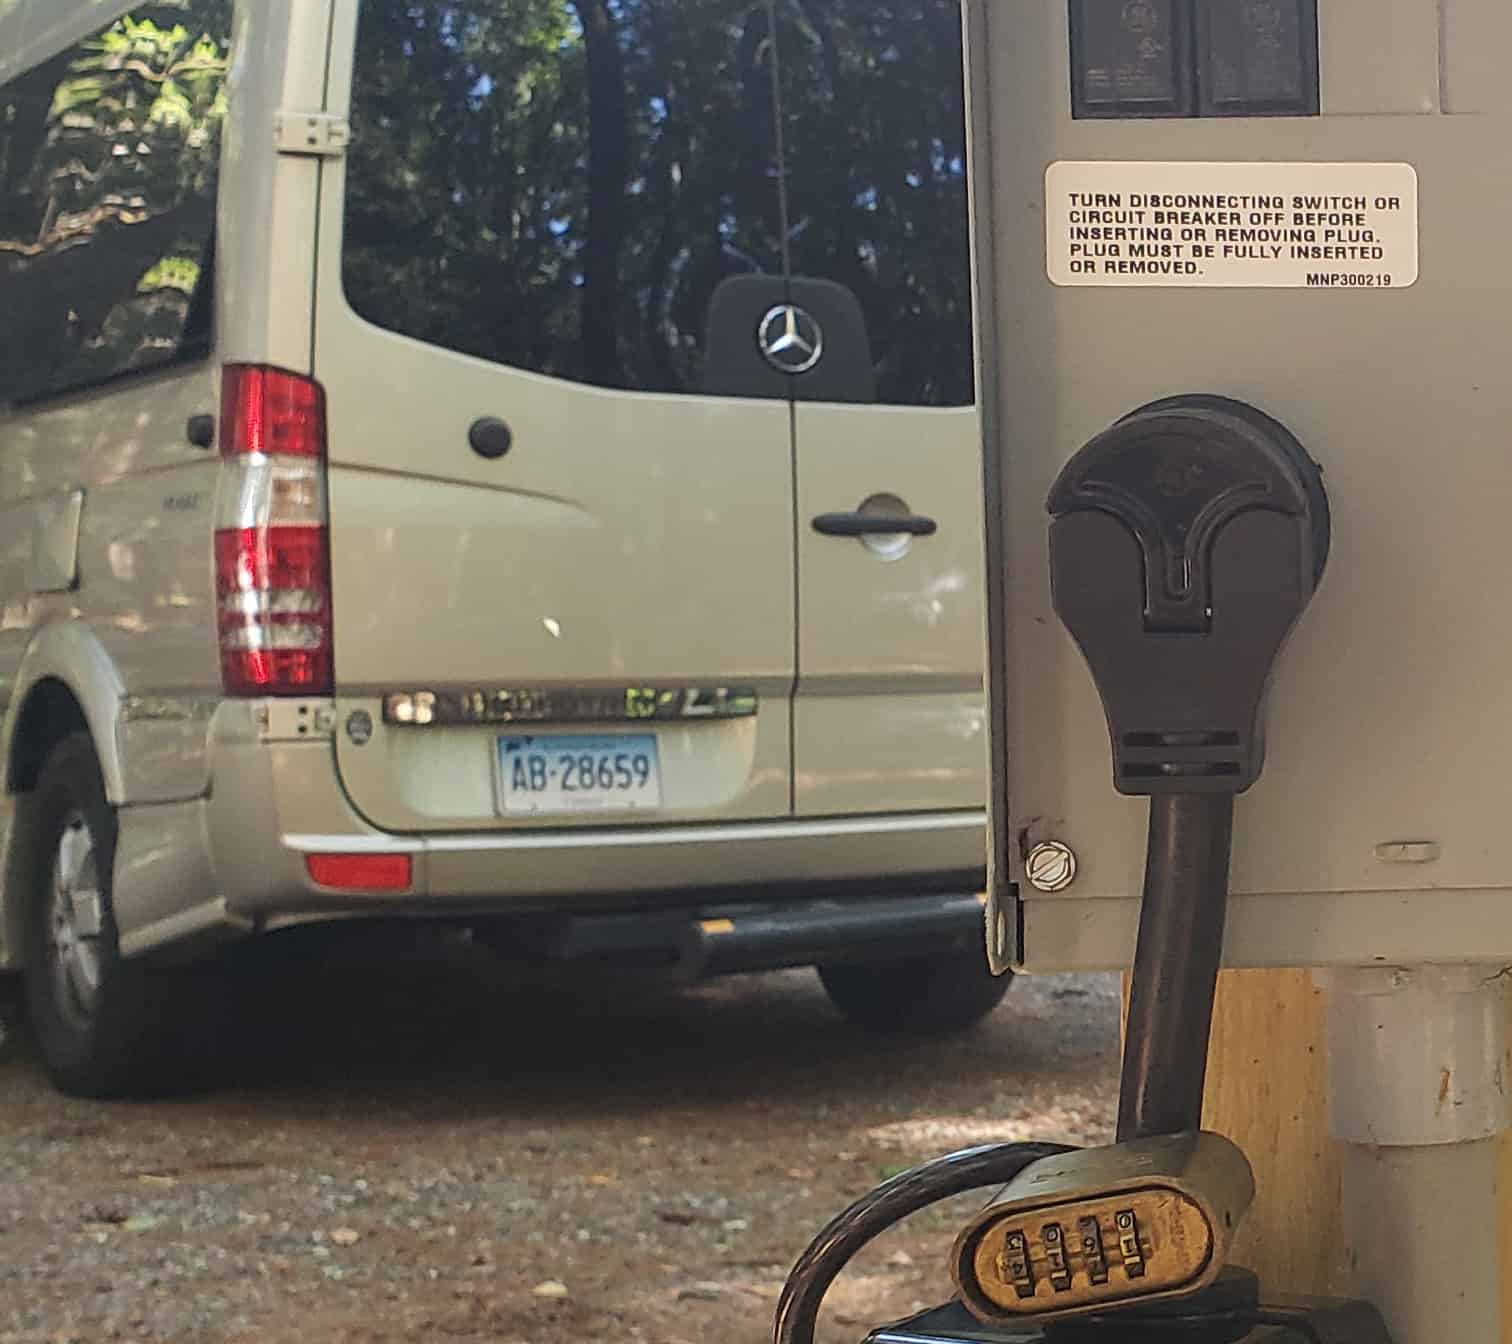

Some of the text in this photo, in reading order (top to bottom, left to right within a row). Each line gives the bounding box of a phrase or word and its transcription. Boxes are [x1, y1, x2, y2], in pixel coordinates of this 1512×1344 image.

[1068, 194, 1400, 209] TURN DISCONNECTING SWITCH OR
[1069, 211, 1365, 226] CIRCUIT BREAKER OFF BEFORE
[1070, 228, 1380, 242] INSERTING OR REMOVING PLUG.
[1070, 244, 1383, 259] PLUG MUST BE FULLY INSERTED
[1069, 260, 1203, 274] OR REMOVED.
[1306, 273, 1391, 285] MNP300219
